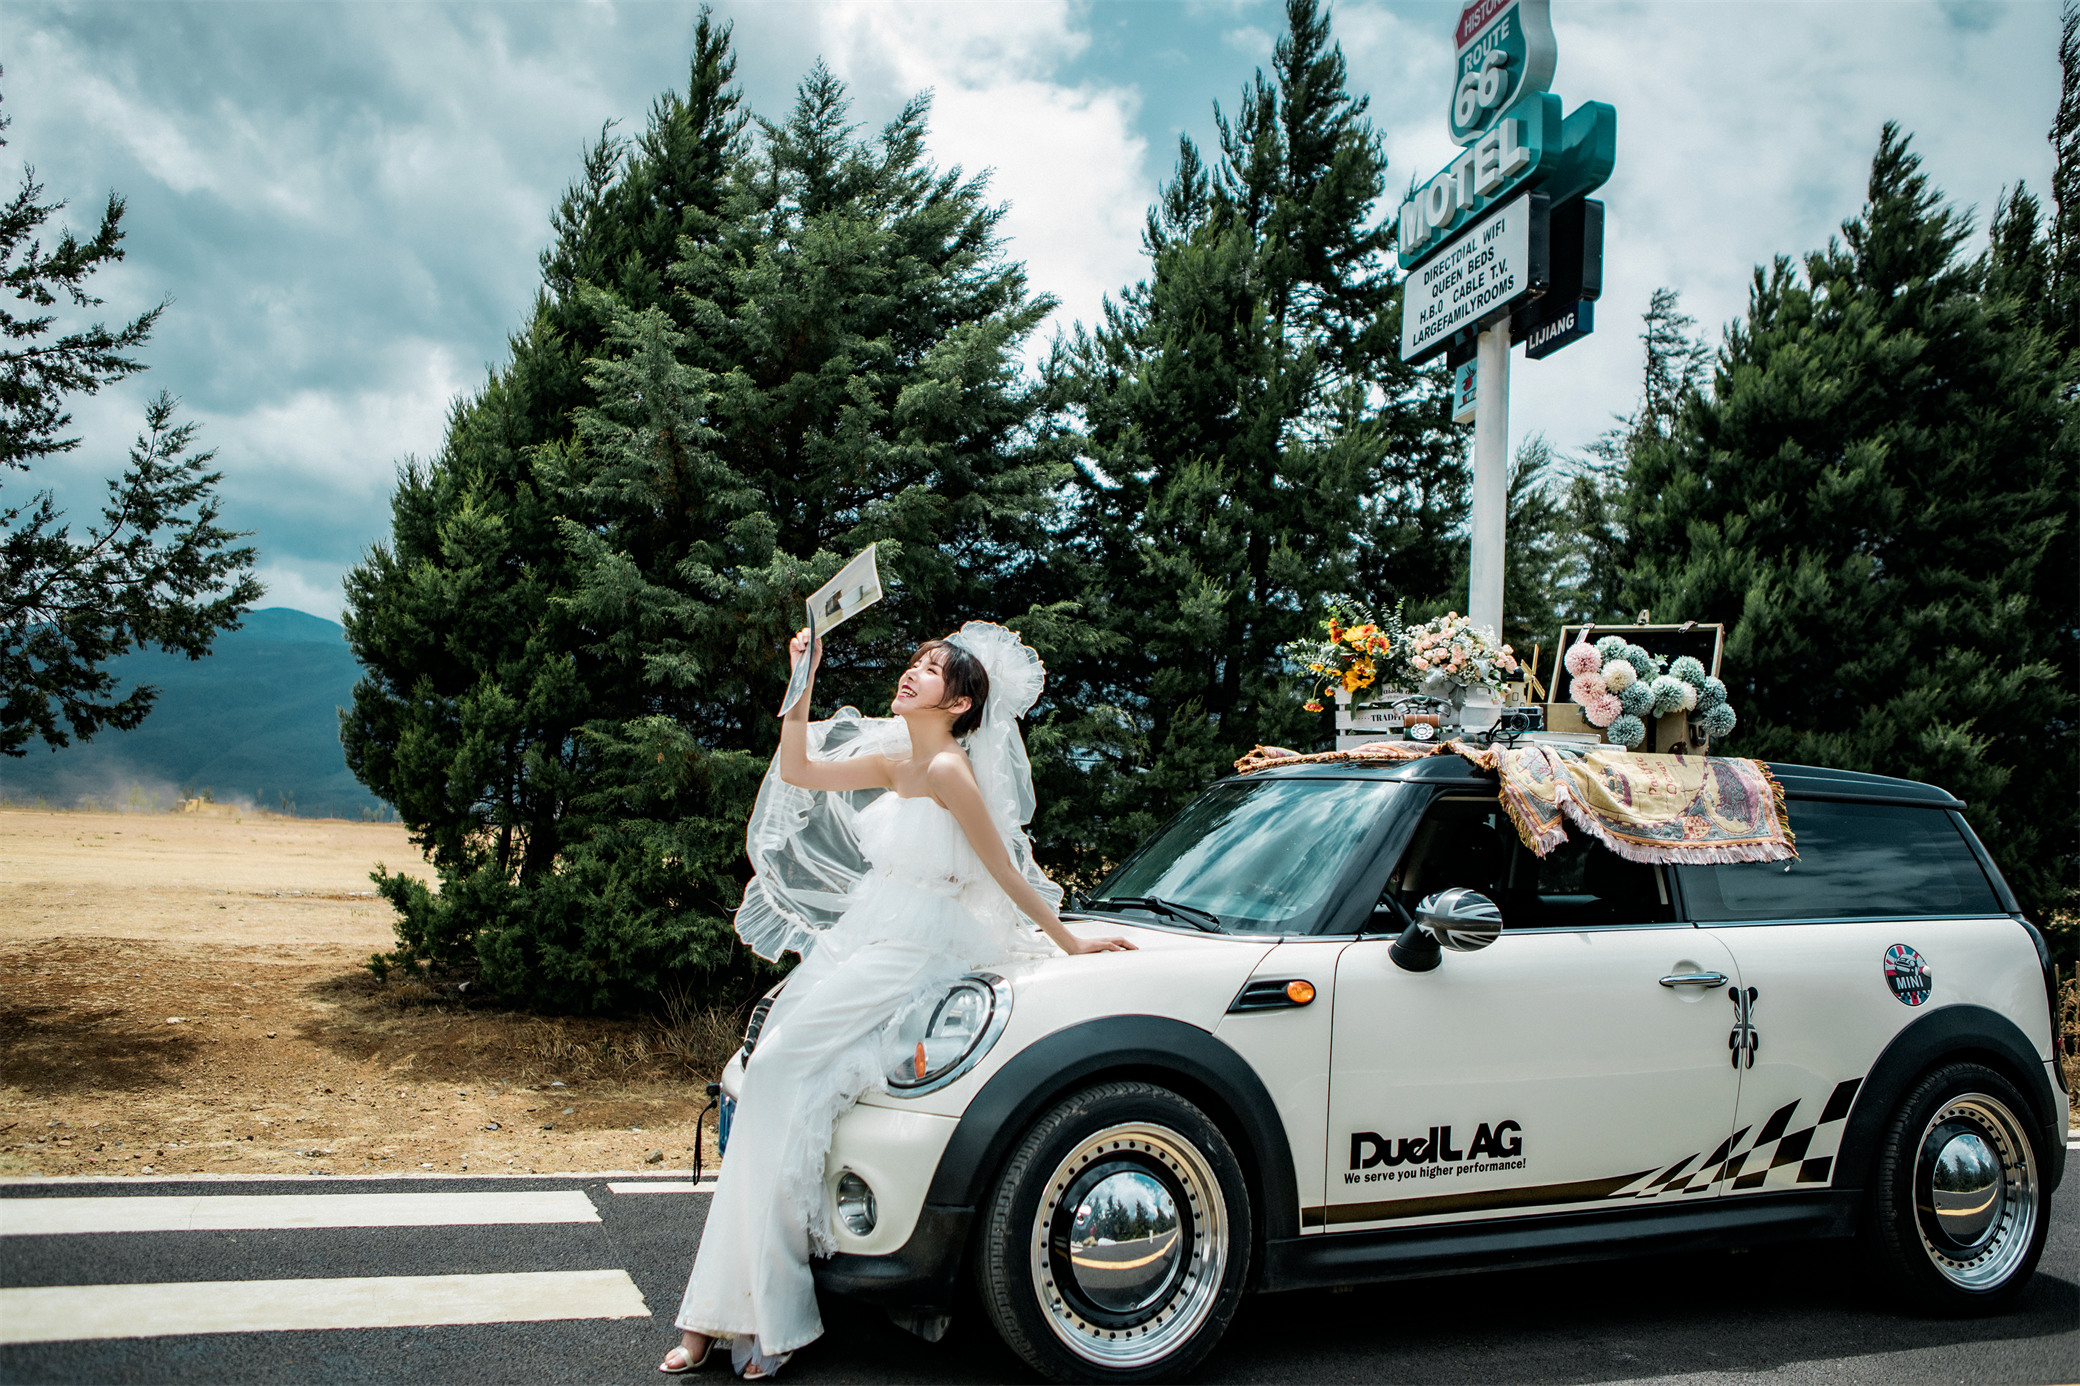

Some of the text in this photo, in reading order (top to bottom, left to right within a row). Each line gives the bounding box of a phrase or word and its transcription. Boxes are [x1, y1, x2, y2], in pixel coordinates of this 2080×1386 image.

[1464, 17, 1510, 74] ROUTE
[1454, 49, 1509, 128] 66
[1399, 117, 1530, 254] MOTEL
[1483, 218, 1505, 245] WIFI
[1432, 246, 1494, 298] QUEEN BEDS
[1453, 272, 1485, 303] CABLE
[1529, 312, 1575, 350] LIJIANG
[1896, 975, 1924, 990] MINI
[1466, 1119, 1522, 1160] AG
[1344, 1157, 1526, 1184] We serve you higher performance!
